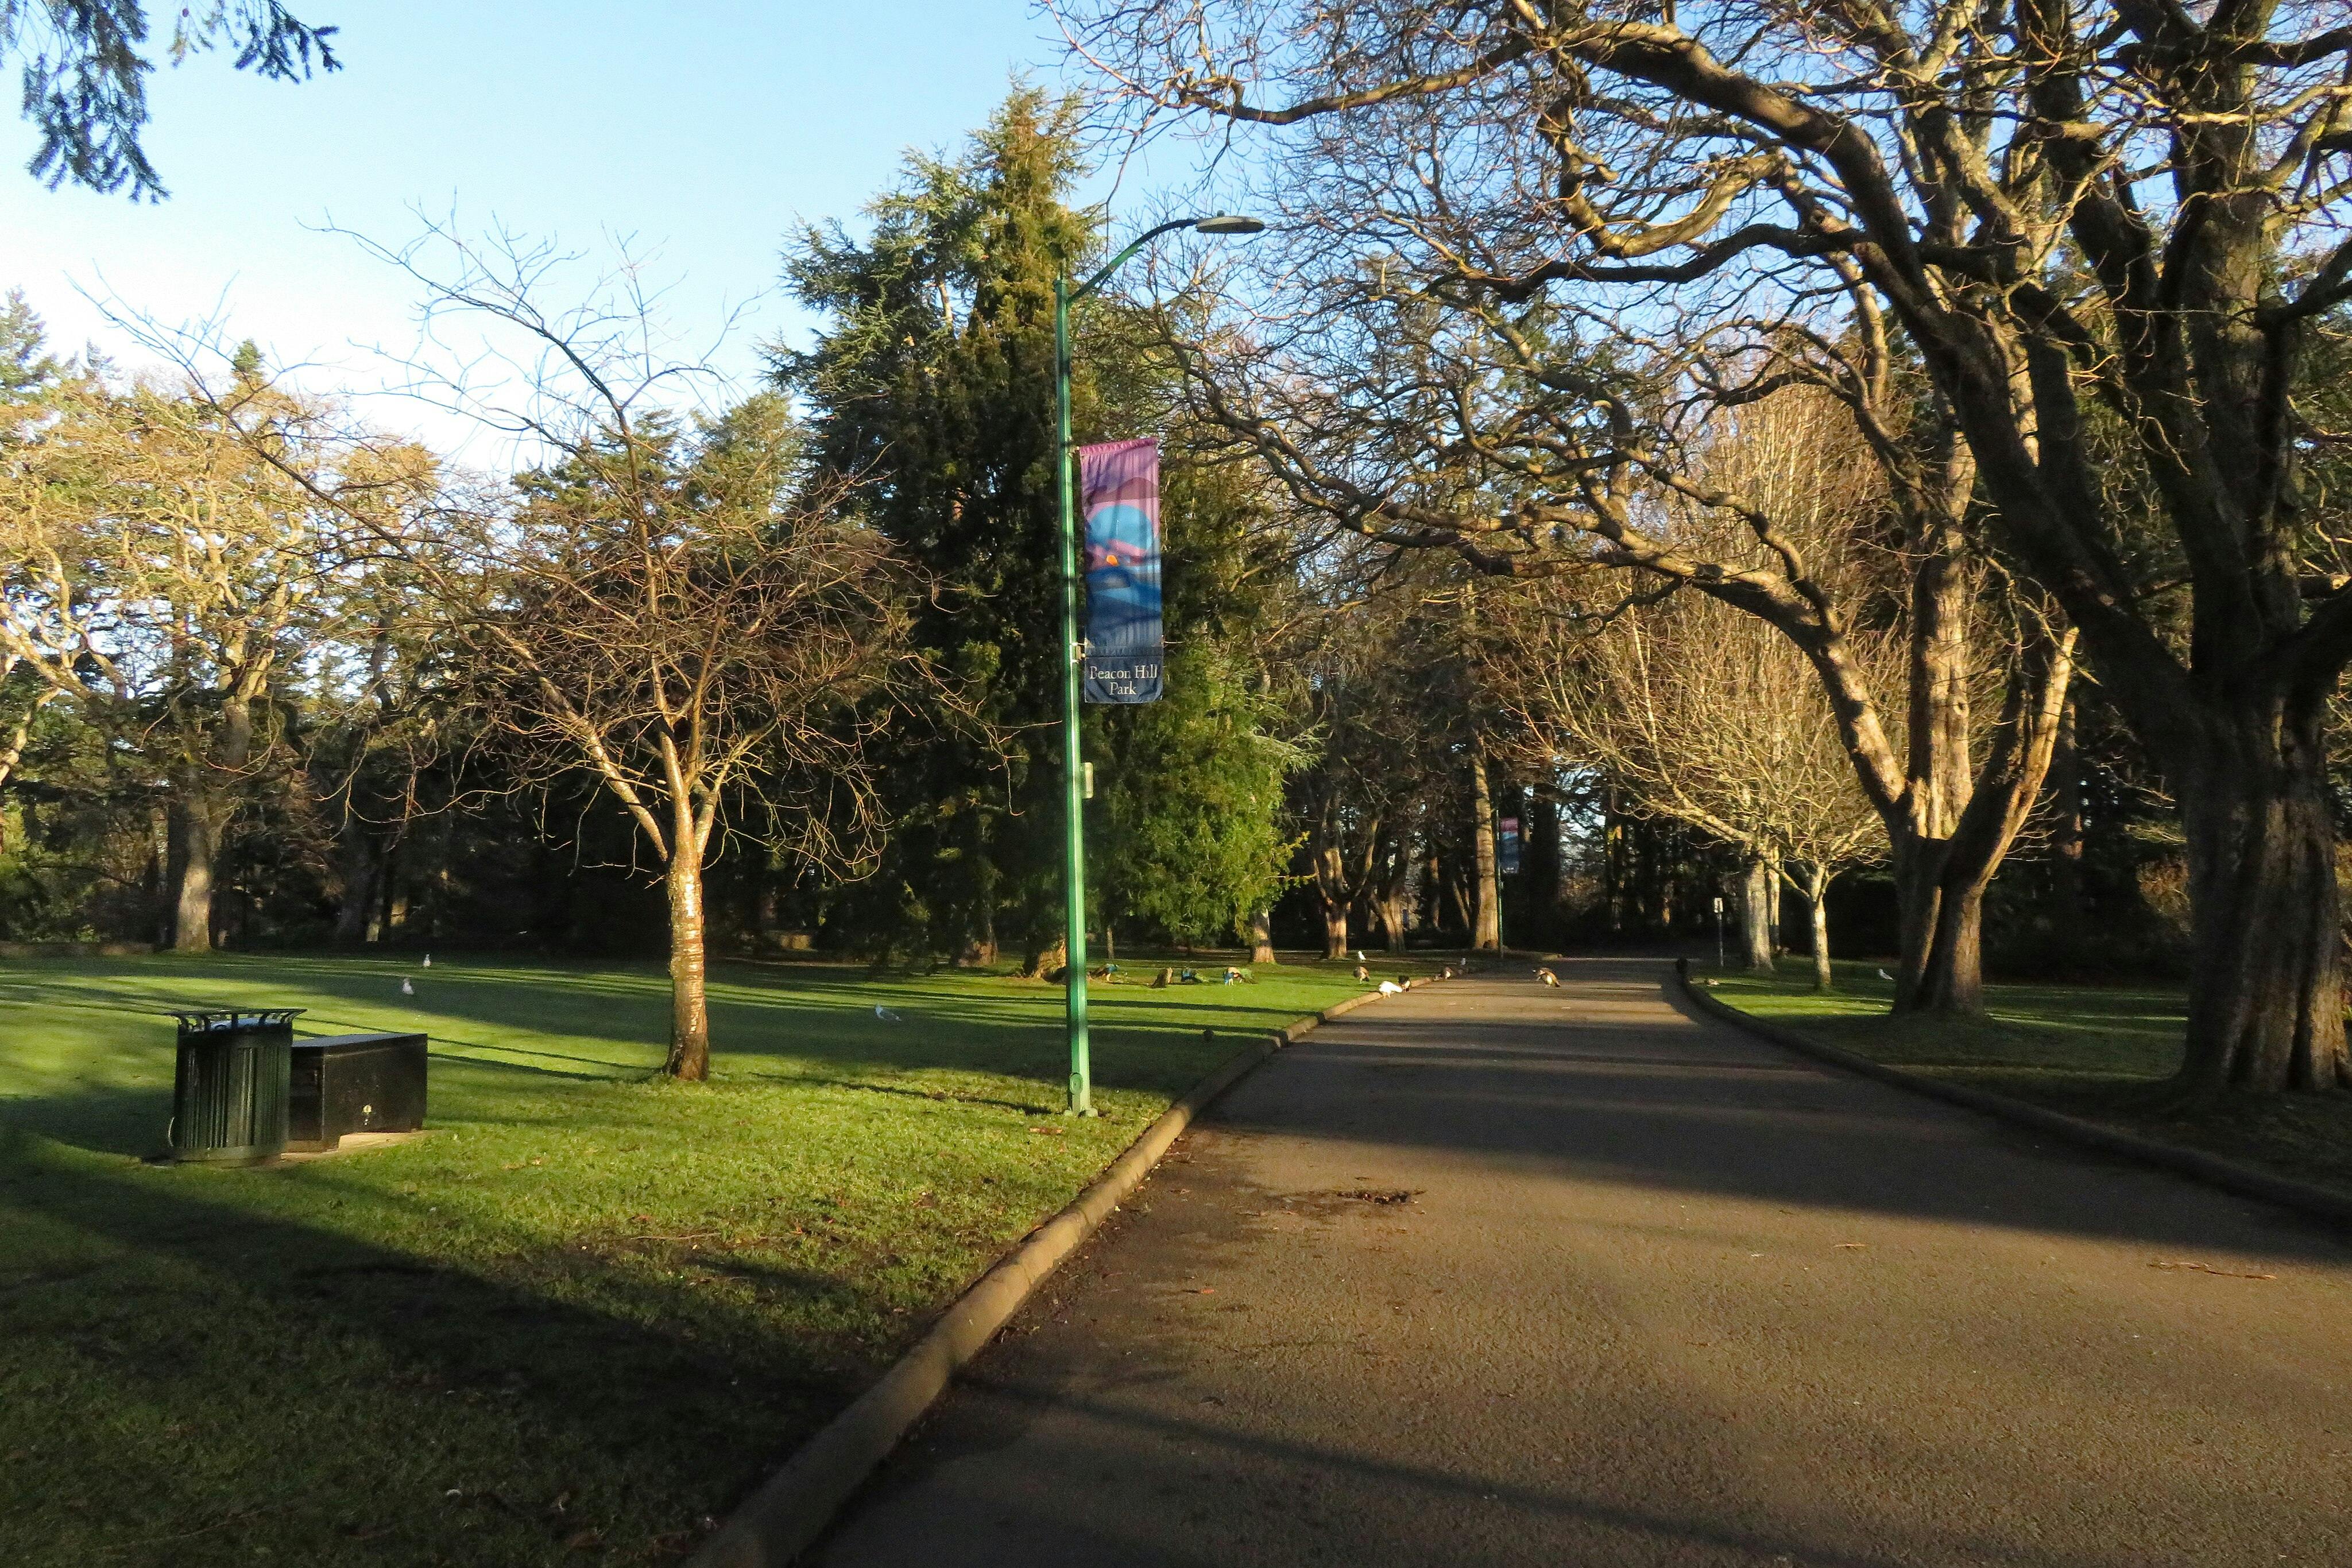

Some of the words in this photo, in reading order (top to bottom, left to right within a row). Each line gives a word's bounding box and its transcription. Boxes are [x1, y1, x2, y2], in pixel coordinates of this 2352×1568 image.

[1089, 666, 1131, 679] Beacon
[1135, 664, 1158, 679] Hill
[1109, 681, 1137, 695] Park
